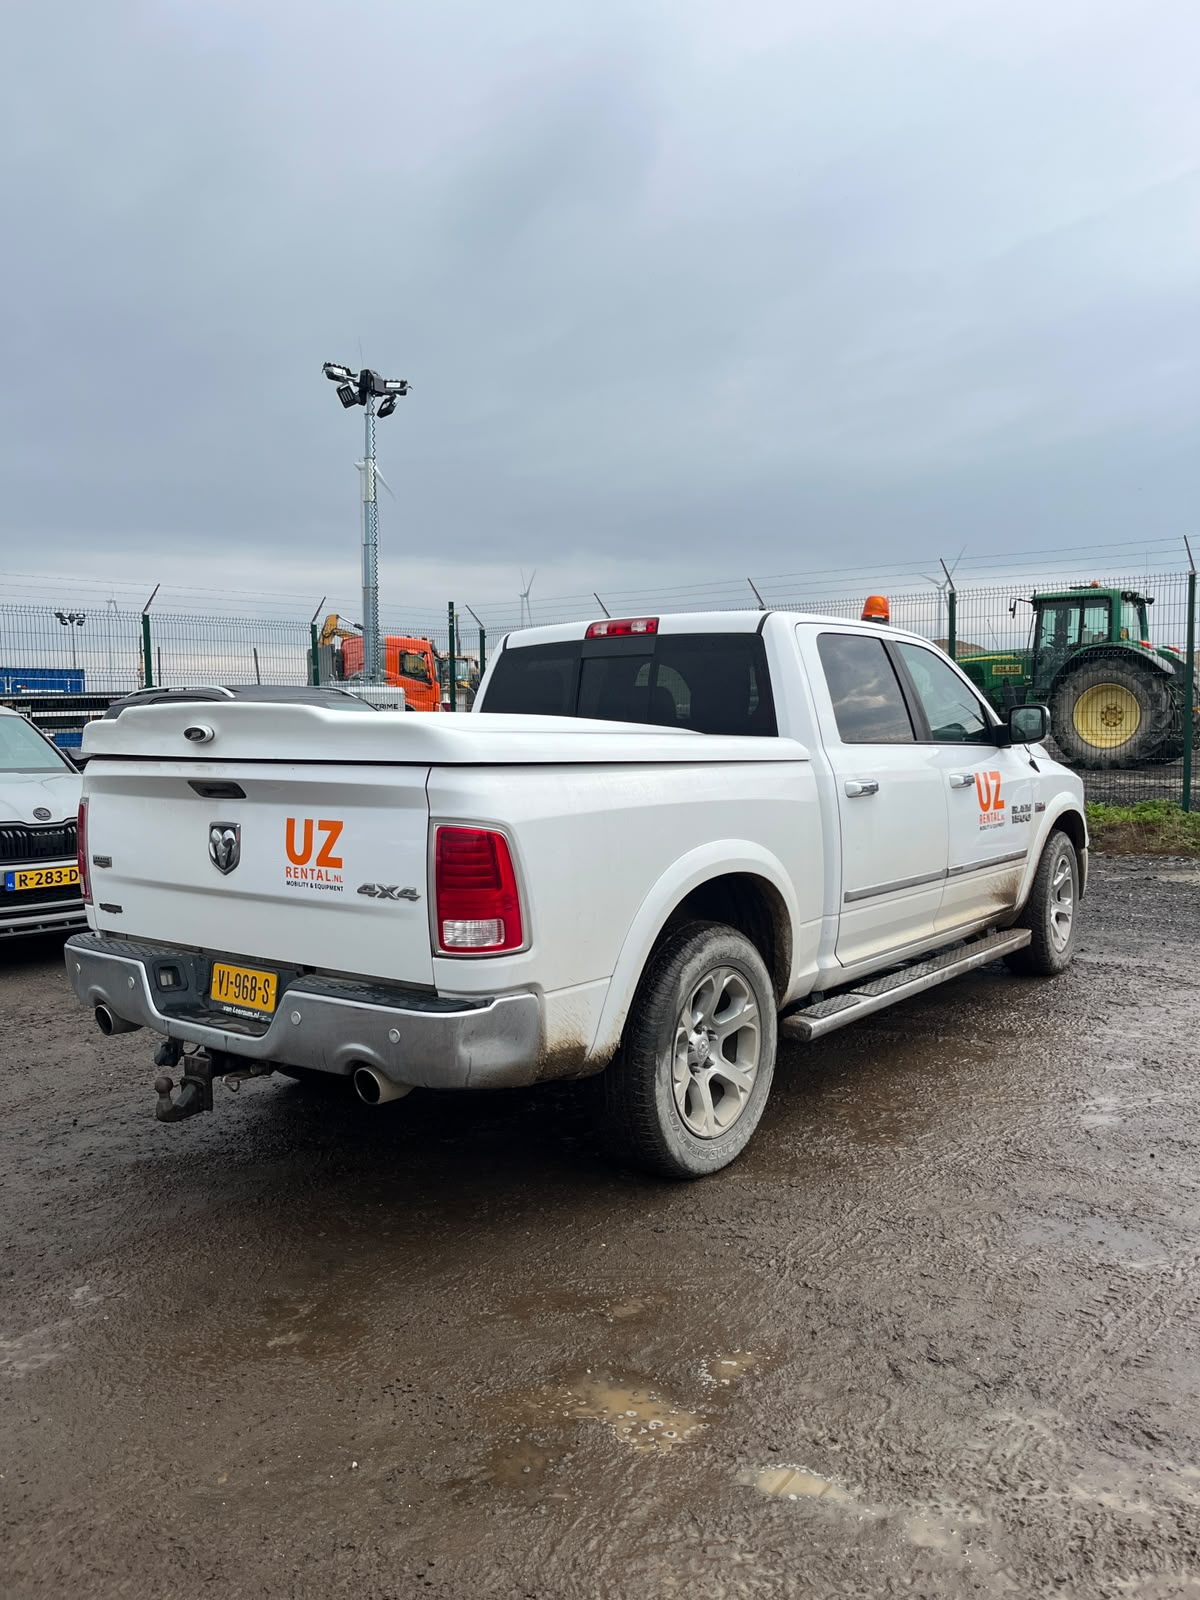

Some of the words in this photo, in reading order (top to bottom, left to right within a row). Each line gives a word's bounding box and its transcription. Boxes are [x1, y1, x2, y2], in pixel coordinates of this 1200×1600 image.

[974, 771, 1005, 812] UZ
[285, 817, 343, 869] UZ
[285, 866, 343, 883] RENTAL.NL
[286, 880, 309, 889] MOBILITY
[314, 883, 344, 892] EQUIPMENT
[357, 882, 421, 901] 4X4
